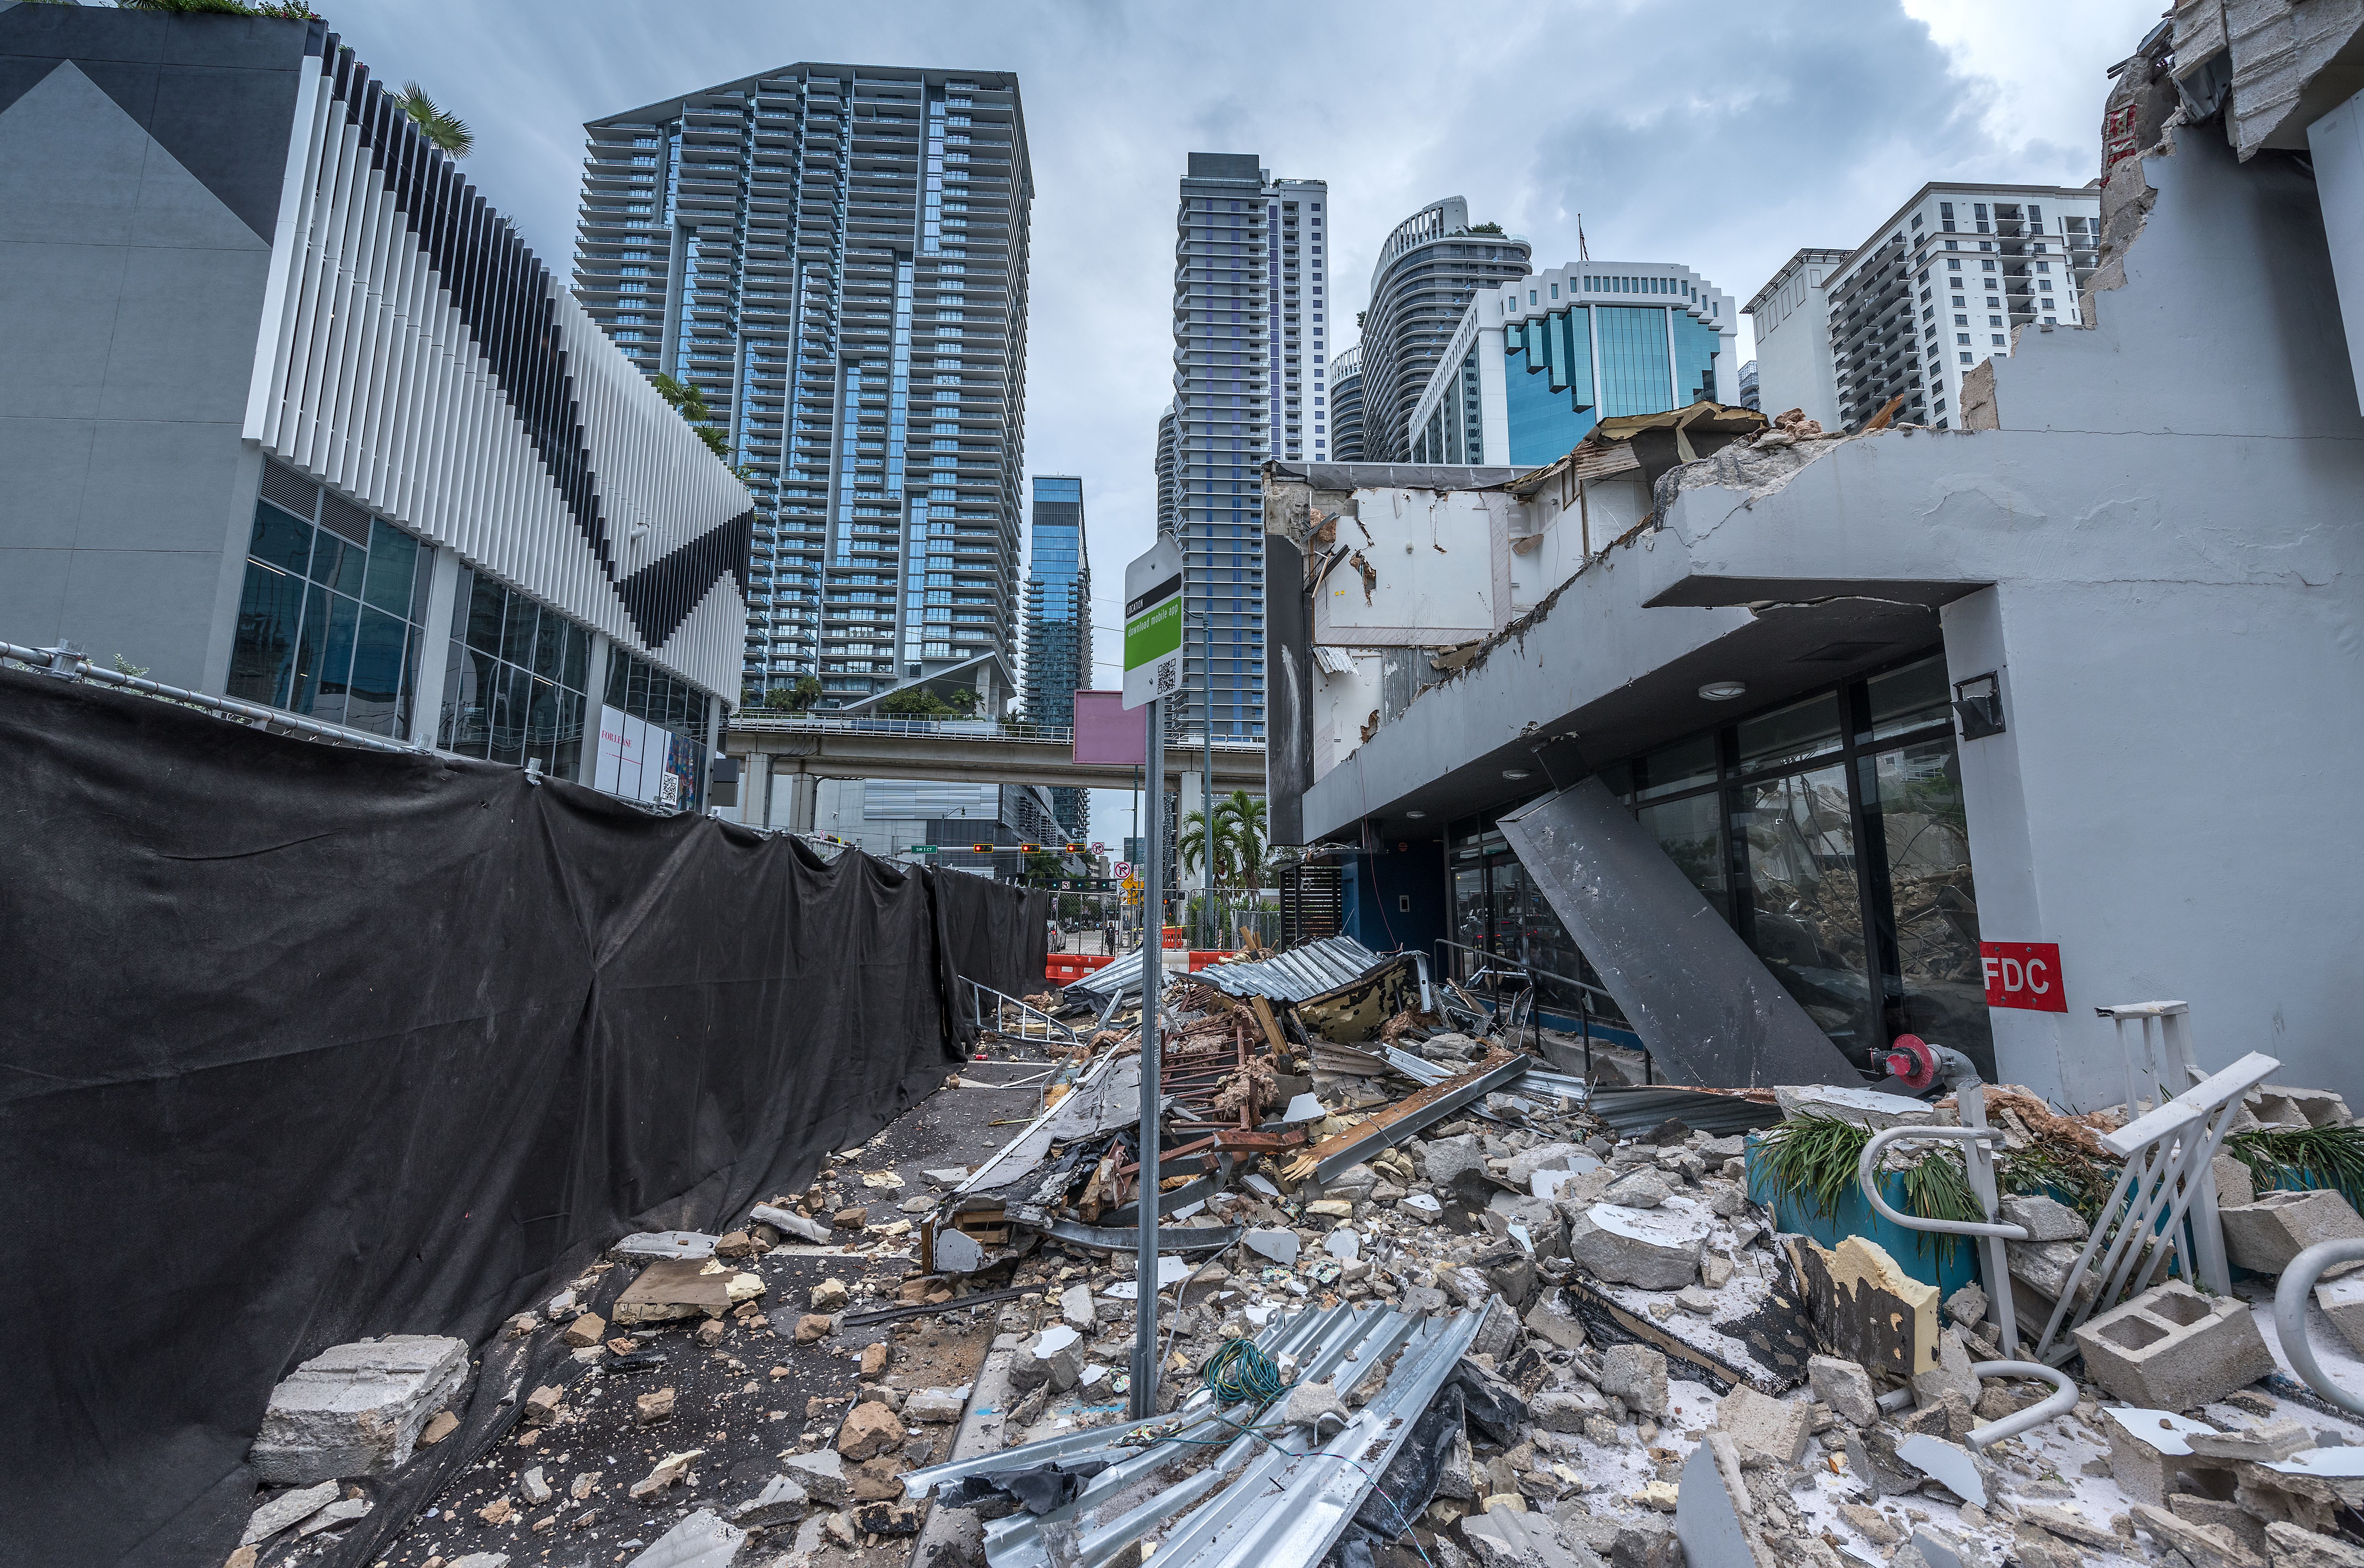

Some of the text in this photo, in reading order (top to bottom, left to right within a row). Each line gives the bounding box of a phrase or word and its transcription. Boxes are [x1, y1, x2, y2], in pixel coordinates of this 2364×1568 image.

[1127, 599, 1143, 615] LOCATION
[1128, 604, 1178, 637] download mobile app
[602, 730, 613, 742] FOR
[1981, 957, 2049, 994] FDC
